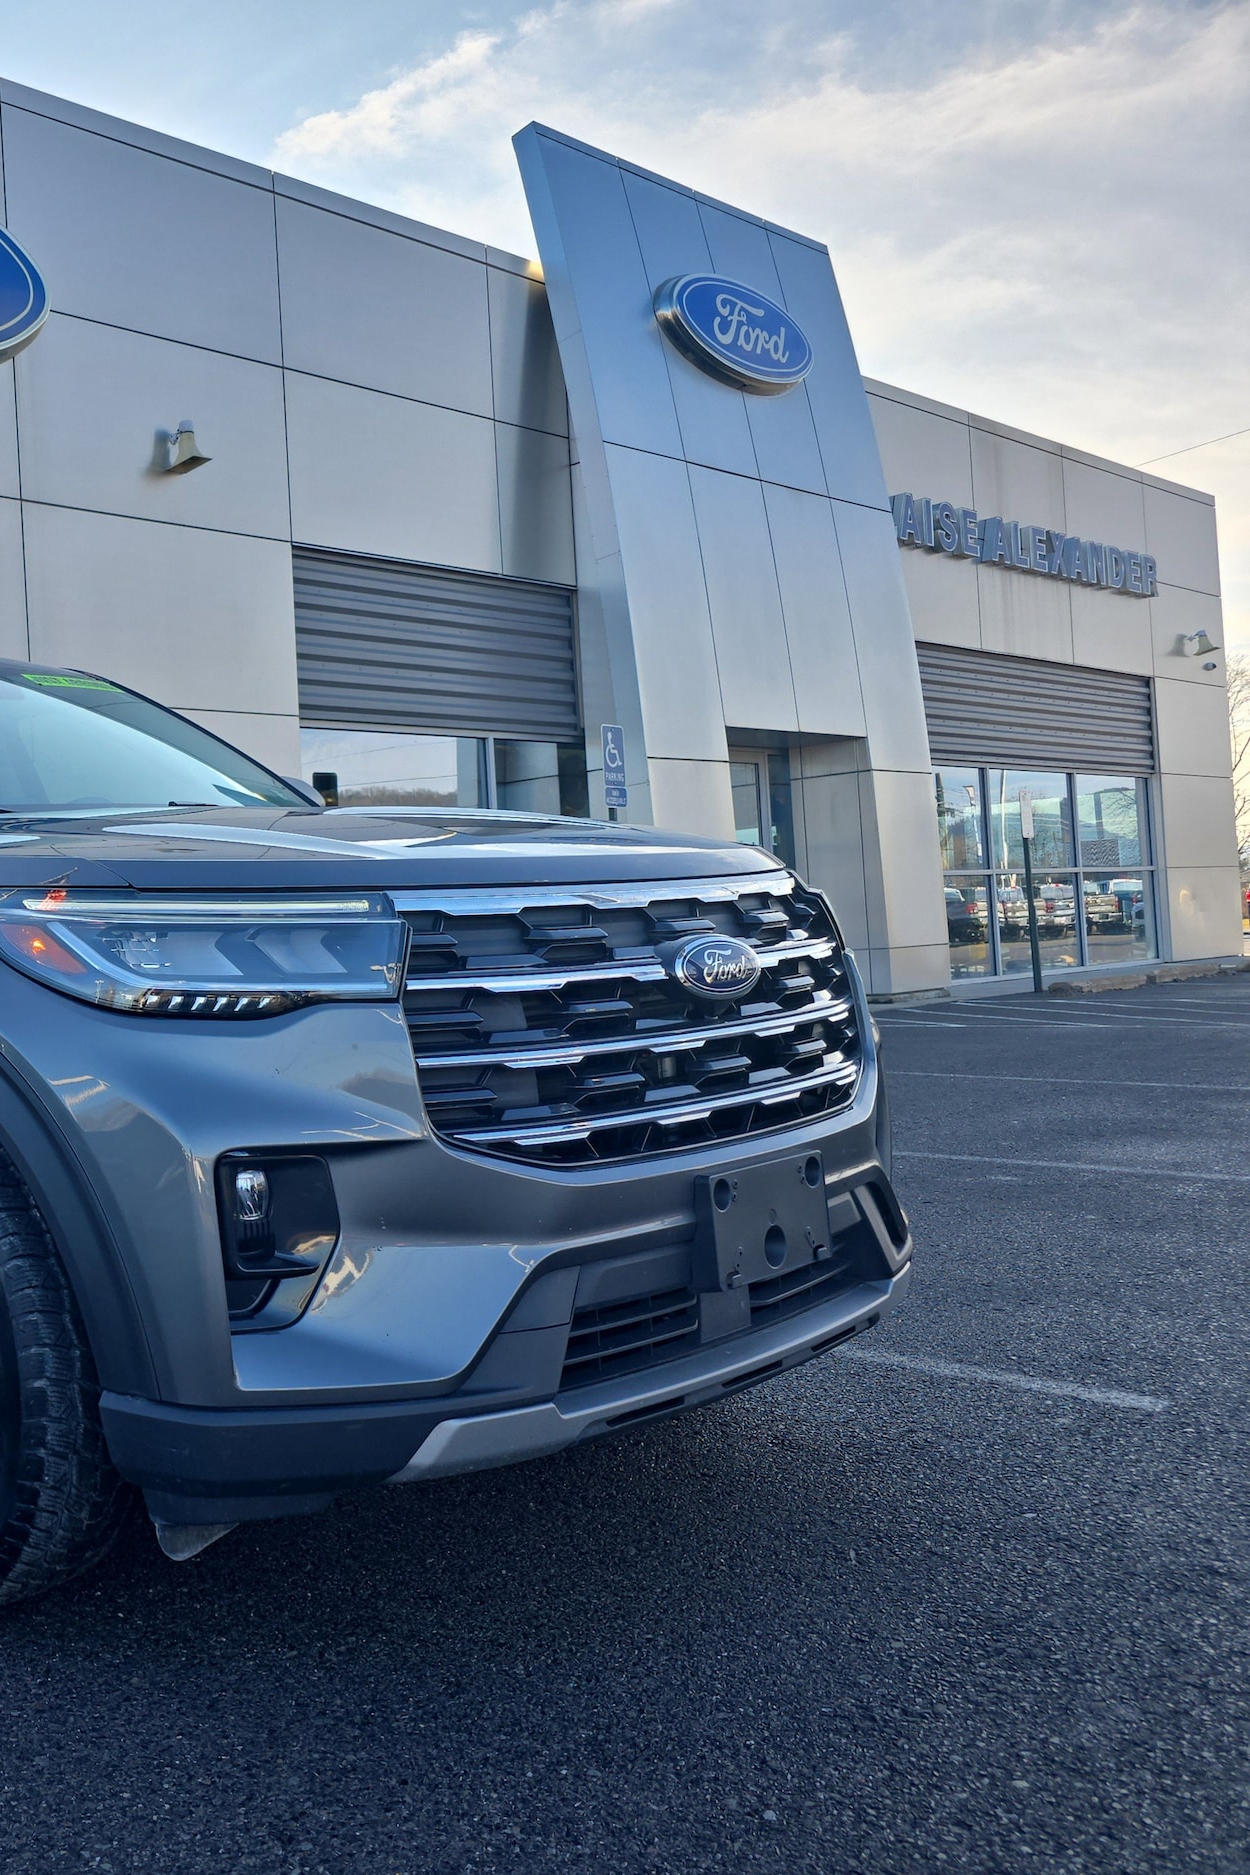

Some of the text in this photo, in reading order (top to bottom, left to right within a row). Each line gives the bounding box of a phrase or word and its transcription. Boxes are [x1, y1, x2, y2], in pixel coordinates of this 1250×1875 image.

[713, 293, 790, 364] Ford
[983, 516, 1159, 597] ALEXANDER
[605, 772, 625, 782] PARKING
[703, 948, 748, 984] Ford
